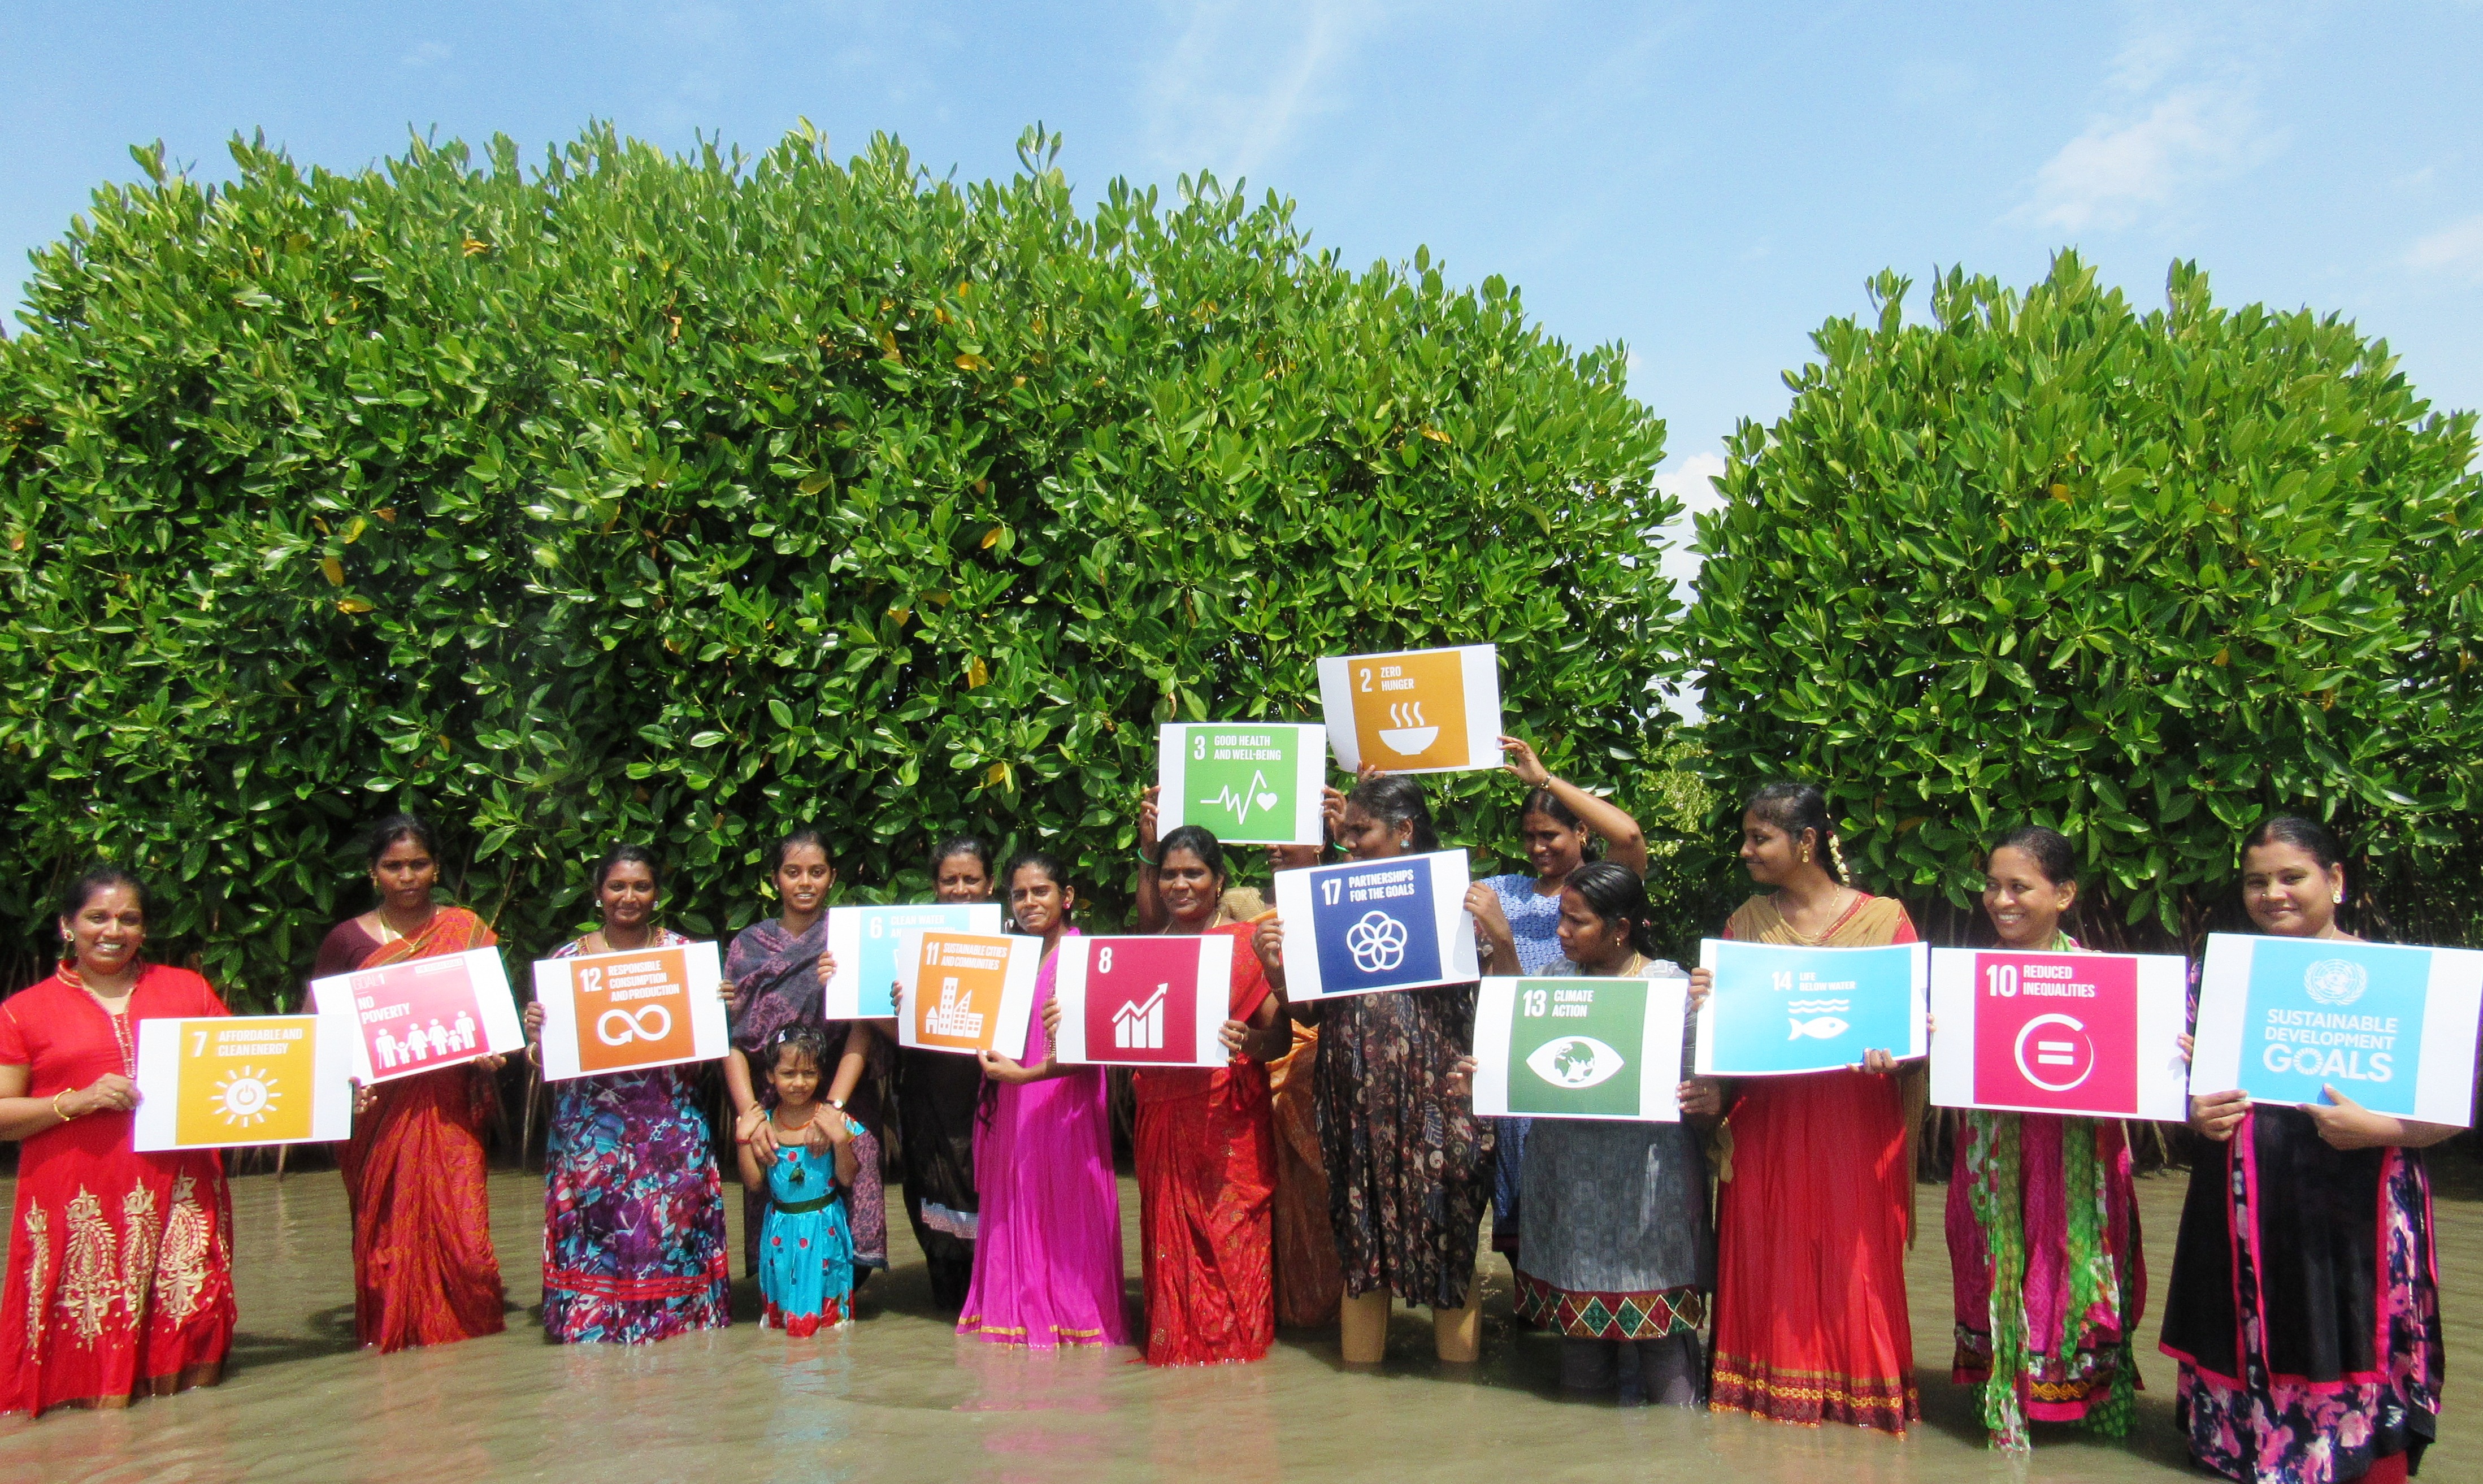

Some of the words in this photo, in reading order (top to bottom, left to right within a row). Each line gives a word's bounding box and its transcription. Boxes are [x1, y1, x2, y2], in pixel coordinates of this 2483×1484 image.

[1360, 668, 1373, 692] 2
[1380, 666, 1401, 678] ZERO
[1381, 678, 1414, 691] HUNGER
[1194, 735, 1206, 760] 3
[1214, 735, 1237, 746] GOOD
[1239, 735, 1270, 746] HEALTH
[1214, 749, 1231, 760] AND
[1232, 749, 1282, 760] WELL-BEING
[1348, 869, 1414, 888] PARTNERSHIPS
[1321, 878, 1342, 905] 17
[1349, 889, 1368, 902] FOR
[1368, 887, 1385, 900] THE
[1386, 883, 1414, 898] GOALS
[870, 916, 883, 938] 6
[891, 915, 915, 925] CLEAN
[918, 914, 944, 925] WATER
[891, 928, 902, 938] AN
[926, 942, 940, 965] 11
[943, 943, 986, 956] SUSTAINABLE
[986, 946, 1008, 958] CITIES
[608, 960, 662, 976] RESPONSIBLE
[941, 956, 954, 967] AND
[954, 957, 1000, 970] COMMUNITIES
[1098, 947, 1113, 974] 8
[580, 967, 602, 992] 12
[1799, 972, 1816, 980] LIFE
[1986, 964, 2017, 997] 10
[2023, 965, 2073, 979] REDUCED
[353, 975, 379, 991] GOAL
[378, 973, 385, 984] 1
[609, 973, 667, 989] CONSUMPTION
[1772, 971, 1792, 991] 14
[1799, 982, 1827, 991] BELOW
[1827, 981, 1856, 990] WATER
[2022, 982, 2095, 997] INEQUALITIES
[611, 991, 628, 1002] AND
[630, 983, 680, 999] PRODUCTION
[1554, 990, 1594, 1002] CLIMATE
[357, 996, 375, 1010] NO
[1522, 990, 1547, 1017] 13
[1551, 1004, 1587, 1017] ACTION
[361, 1003, 410, 1024] POVERTY
[2267, 1008, 2398, 1034] SUSTAINABLE
[219, 1029, 280, 1042] AFFORDABLE
[283, 1028, 303, 1040] AND
[2264, 1026, 2395, 1050] DEVELOPMENT
[193, 1031, 207, 1057] 7
[218, 1044, 250, 1057] CLEAN
[251, 1043, 289, 1055] ENERGY
[2263, 1043, 2394, 1082] GOALS
